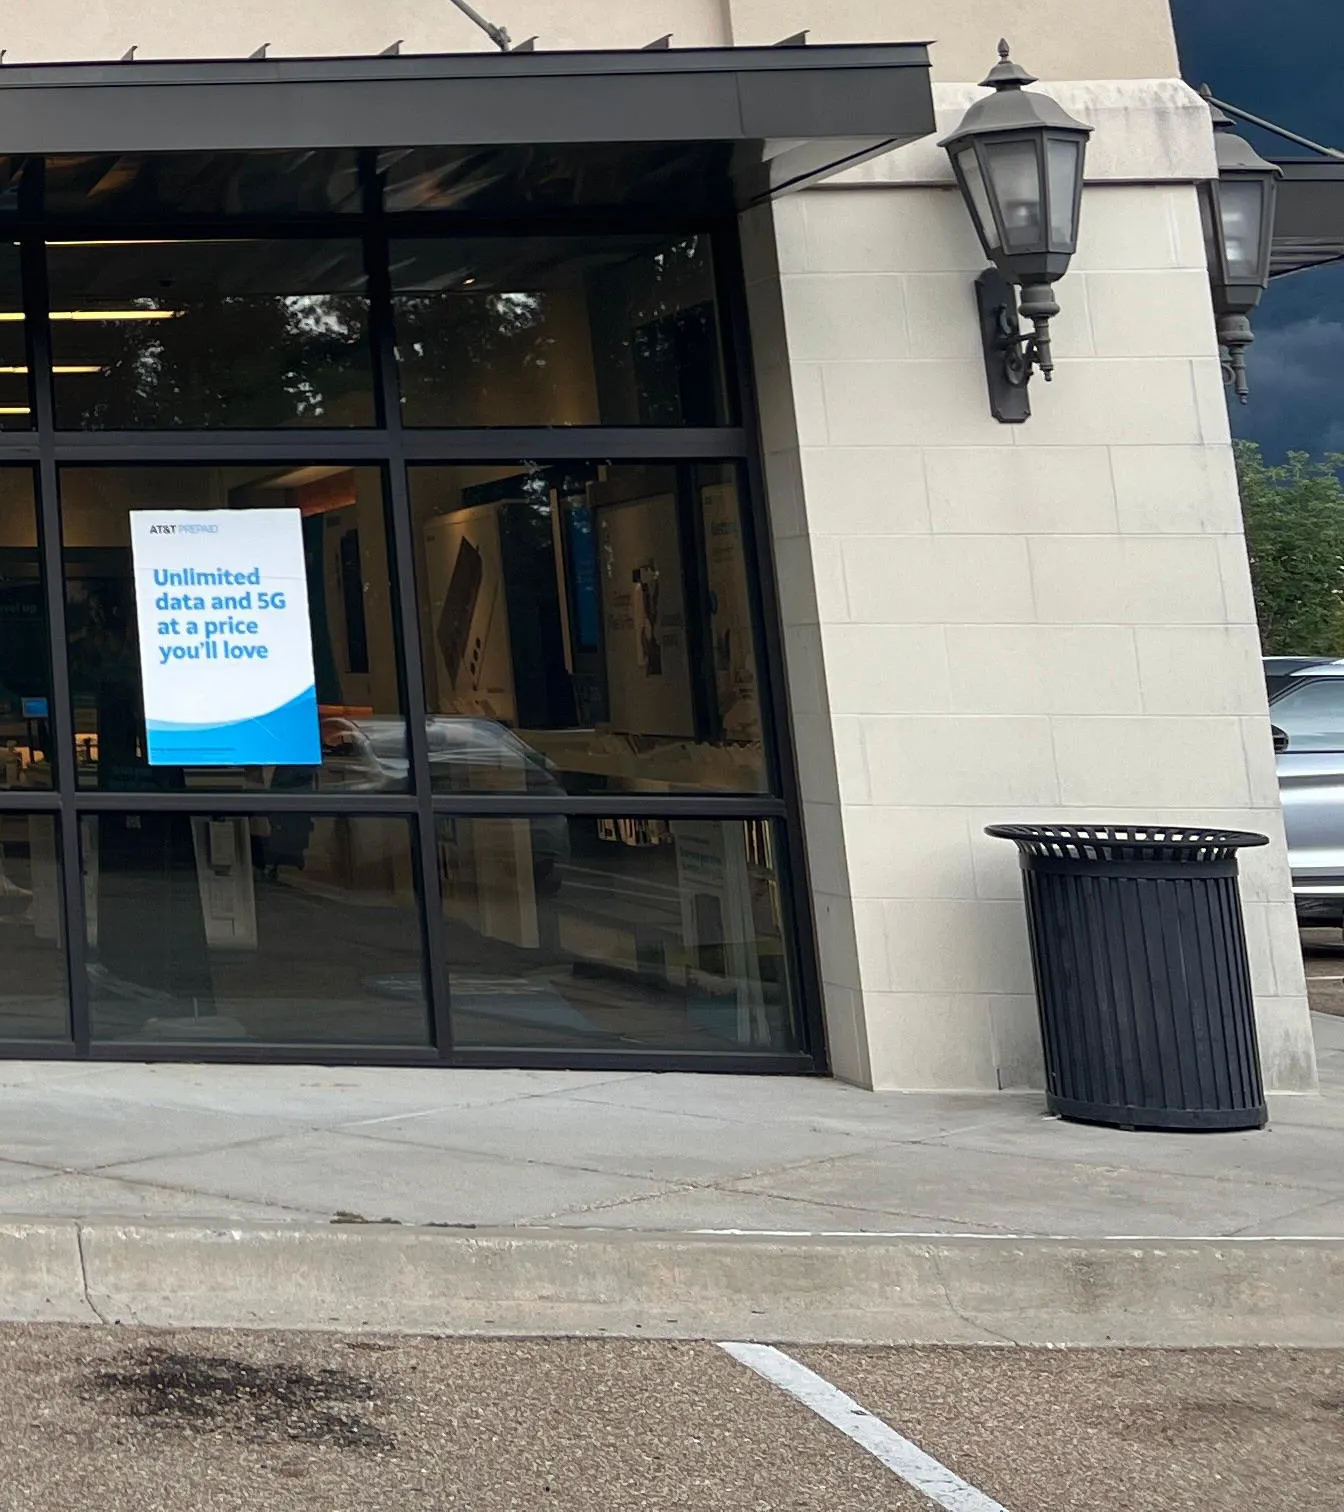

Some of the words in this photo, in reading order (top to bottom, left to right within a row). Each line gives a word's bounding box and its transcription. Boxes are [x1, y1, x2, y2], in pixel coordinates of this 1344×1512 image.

[149, 524, 177, 535] AT&T
[153, 567, 261, 586] Unlimited
[155, 592, 205, 610] data
[211, 591, 252, 610] and
[257, 591, 287, 610] 5G
[158, 618, 180, 635] at
[186, 621, 198, 635] a
[204, 616, 259, 638] price
[158, 640, 218, 665] you'll
[223, 640, 269, 660] love
